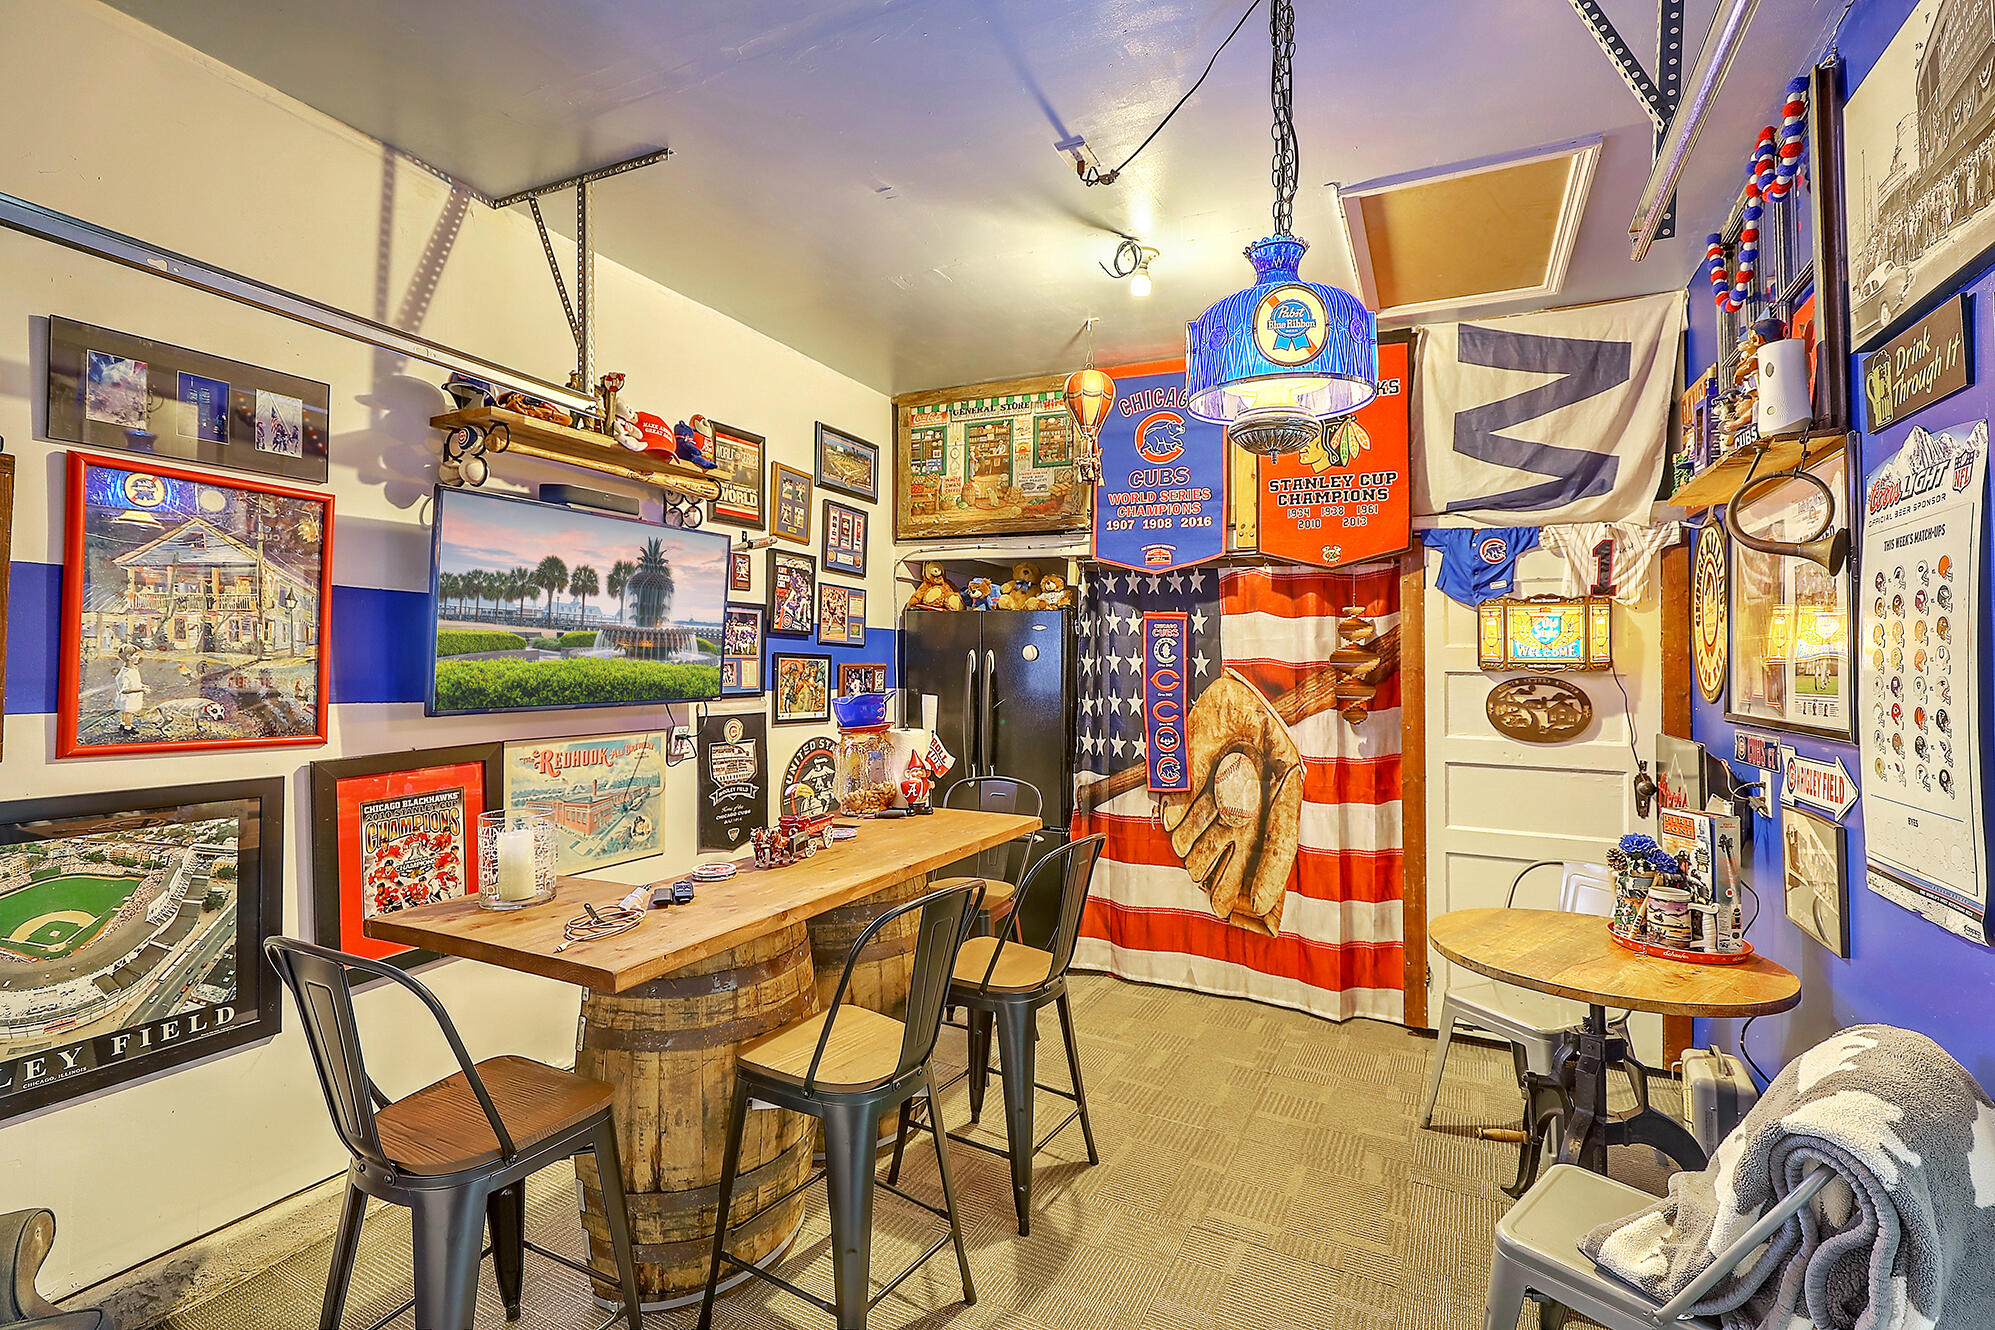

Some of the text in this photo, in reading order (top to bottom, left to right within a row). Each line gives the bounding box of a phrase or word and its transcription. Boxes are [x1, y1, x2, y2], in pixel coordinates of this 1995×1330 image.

[1278, 304, 1306, 318] Pabst
[1267, 319, 1315, 330] Blue Ribbon
[1895, 325, 1931, 377] Drink
[1893, 332, 1960, 408] Through It
[953, 405, 996, 417] GENERAL
[1000, 401, 1030, 412] STORE
[1118, 386, 1189, 418] CHICAG
[642, 421, 659, 430] MAKE
[912, 412, 945, 424] Coca-Cola
[644, 427, 663, 437] GREAT
[1734, 424, 1758, 451] CUBS
[1128, 465, 1191, 489] CUBS
[1269, 471, 1398, 492] STANLEY CUP
[1868, 480, 1902, 515] Coors
[1900, 459, 1952, 501] LIGHT
[1953, 466, 1971, 488] NFL
[720, 488, 759, 507] WORLD
[1108, 488, 1212, 506] WORLD SERIES
[1277, 488, 1390, 507] CHAMPIONS
[1117, 502, 1202, 518] CHAMPIONS
[1287, 504, 1379, 518] 1934 1938 1961
[1868, 492, 1947, 528] OFFICIAL BEER SPONSOR
[1106, 515, 1212, 531] 1907 1908 2016
[1298, 516, 1367, 529] 2010 2013
[1883, 523, 1947, 553] THIS WEEK'S MATCH-UPS
[1590, 538, 1618, 597] 1
[1152, 628, 1180, 638] CUBS
[1516, 641, 1577, 658] WELCOME
[931, 737, 948, 764] ROLL
[785, 738, 839, 785] UNITED STA
[1822, 771, 1845, 804] FIELD
[364, 792, 460, 814] CHICAGO BLACKHAWKS
[365, 801, 458, 822] 2010 STANLEY CUP
[366, 807, 461, 854] CHAMPIONS
[1665, 814, 1693, 828] FIRE
[1665, 824, 1694, 837] ZONE
[395, 858, 437, 873] CHAMPIONS
[1662, 948, 1690, 960] Schaefer
[0, 1006, 236, 1094] EY FIELD
[22, 1066, 88, 1090] CHICAGO, ILLINOIS
